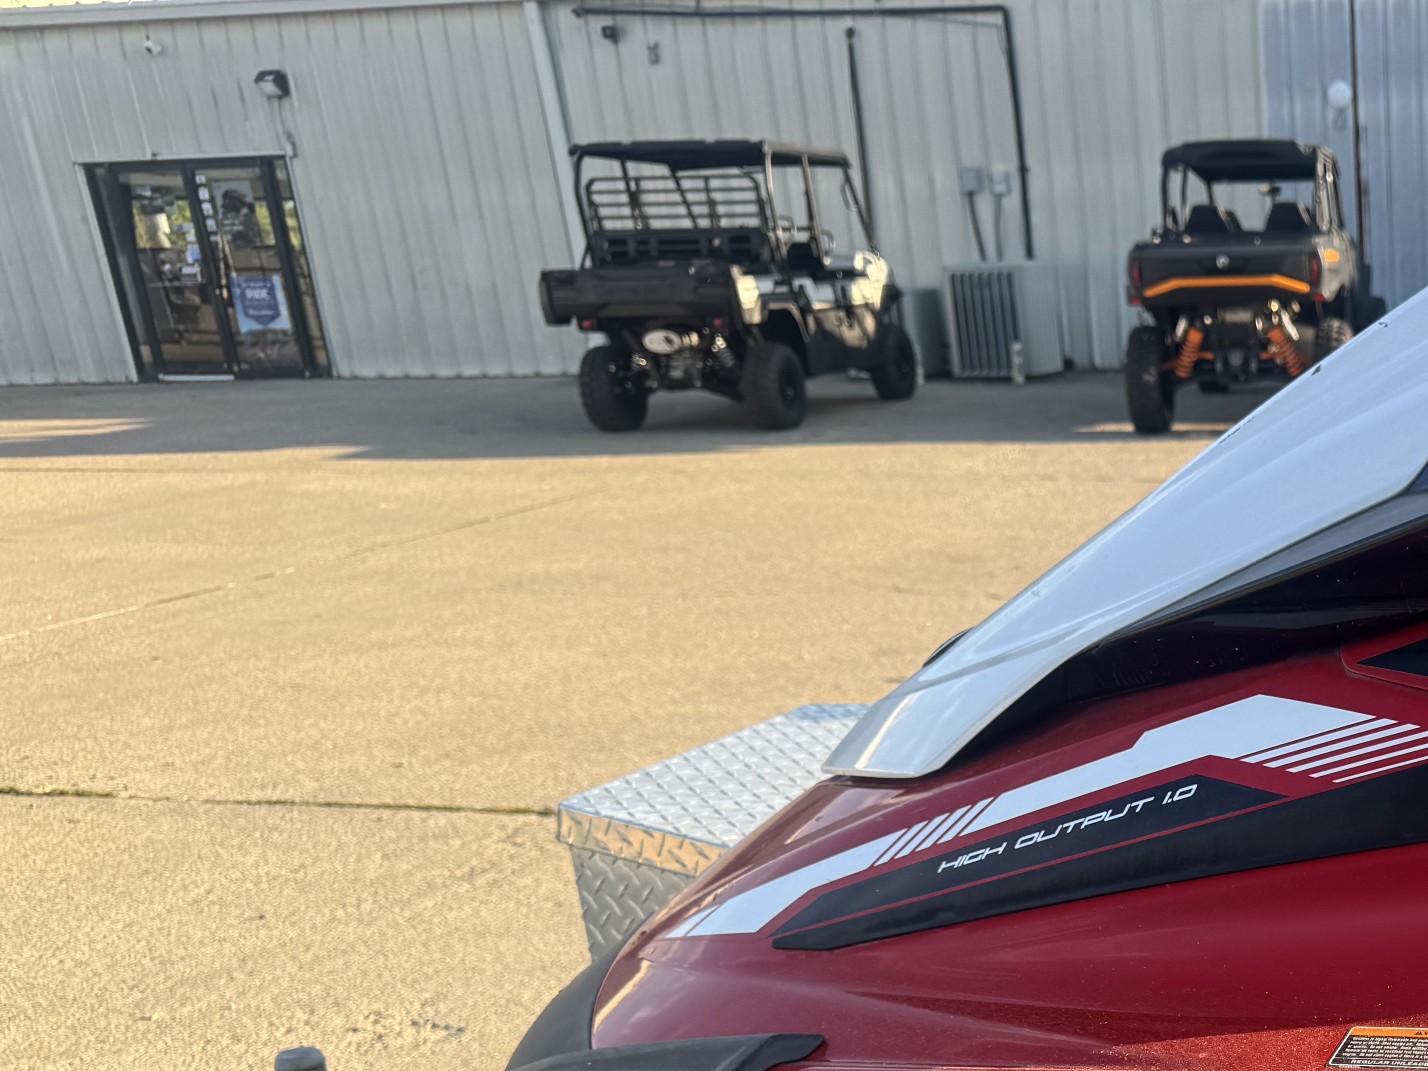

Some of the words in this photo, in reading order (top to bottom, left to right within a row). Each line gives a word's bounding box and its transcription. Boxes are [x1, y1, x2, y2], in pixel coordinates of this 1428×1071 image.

[937, 842, 1007, 874] HIGH
[1014, 796, 1155, 849] OUTPUT
[1162, 784, 1198, 805] 1.0
[1350, 1059, 1391, 1067] REGULAR
